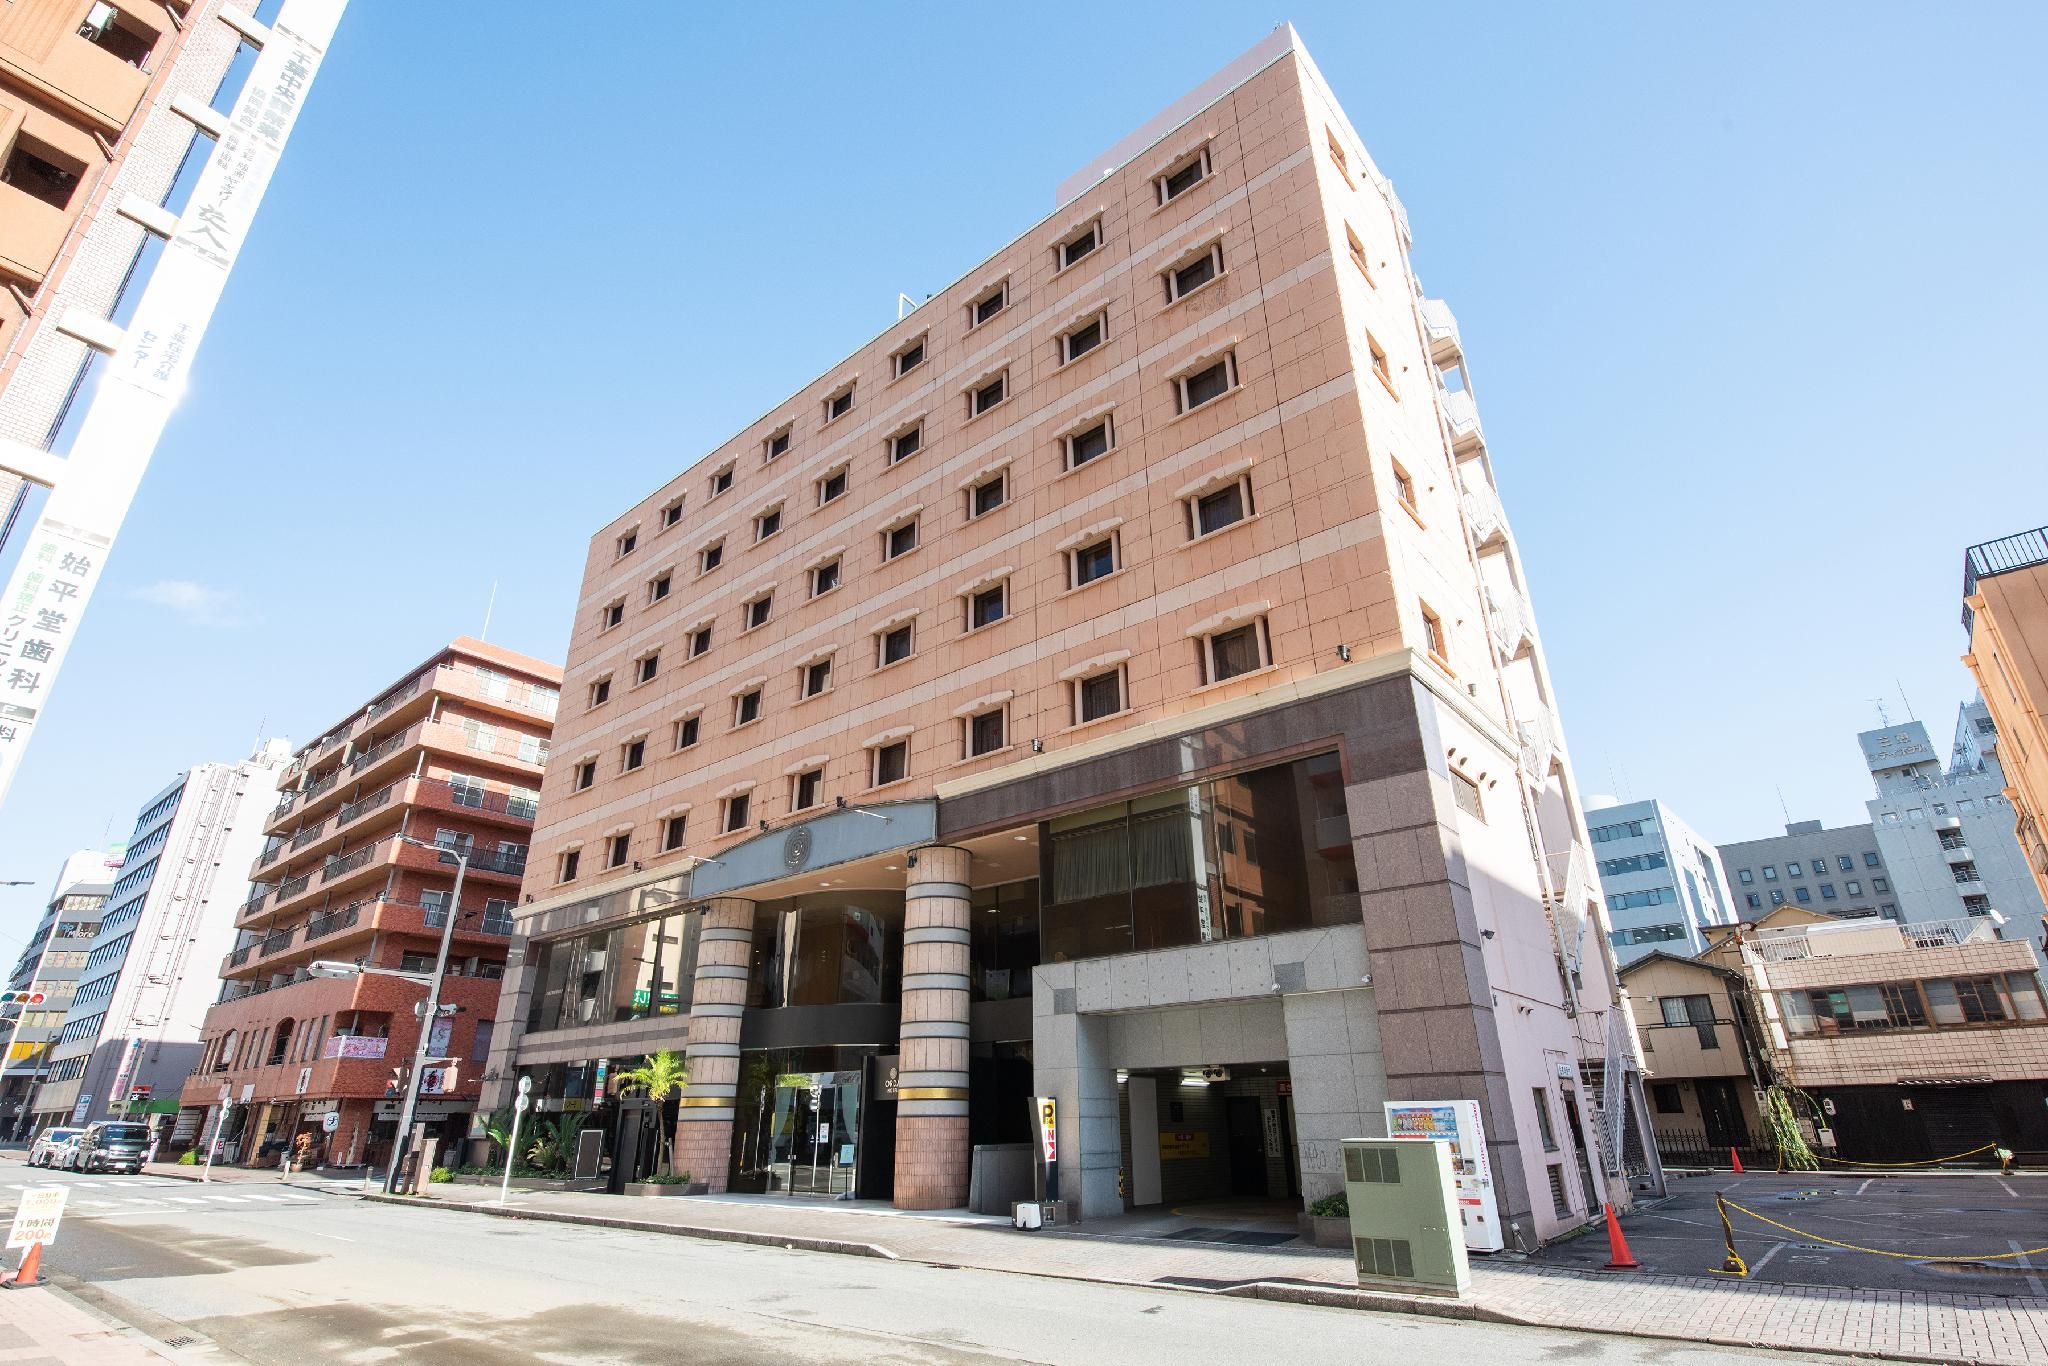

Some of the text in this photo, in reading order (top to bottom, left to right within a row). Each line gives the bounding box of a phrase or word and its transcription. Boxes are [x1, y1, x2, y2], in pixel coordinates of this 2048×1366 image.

[7, 551, 92, 693] 始平堂歯科
[1042, 1104, 1055, 1125] P
